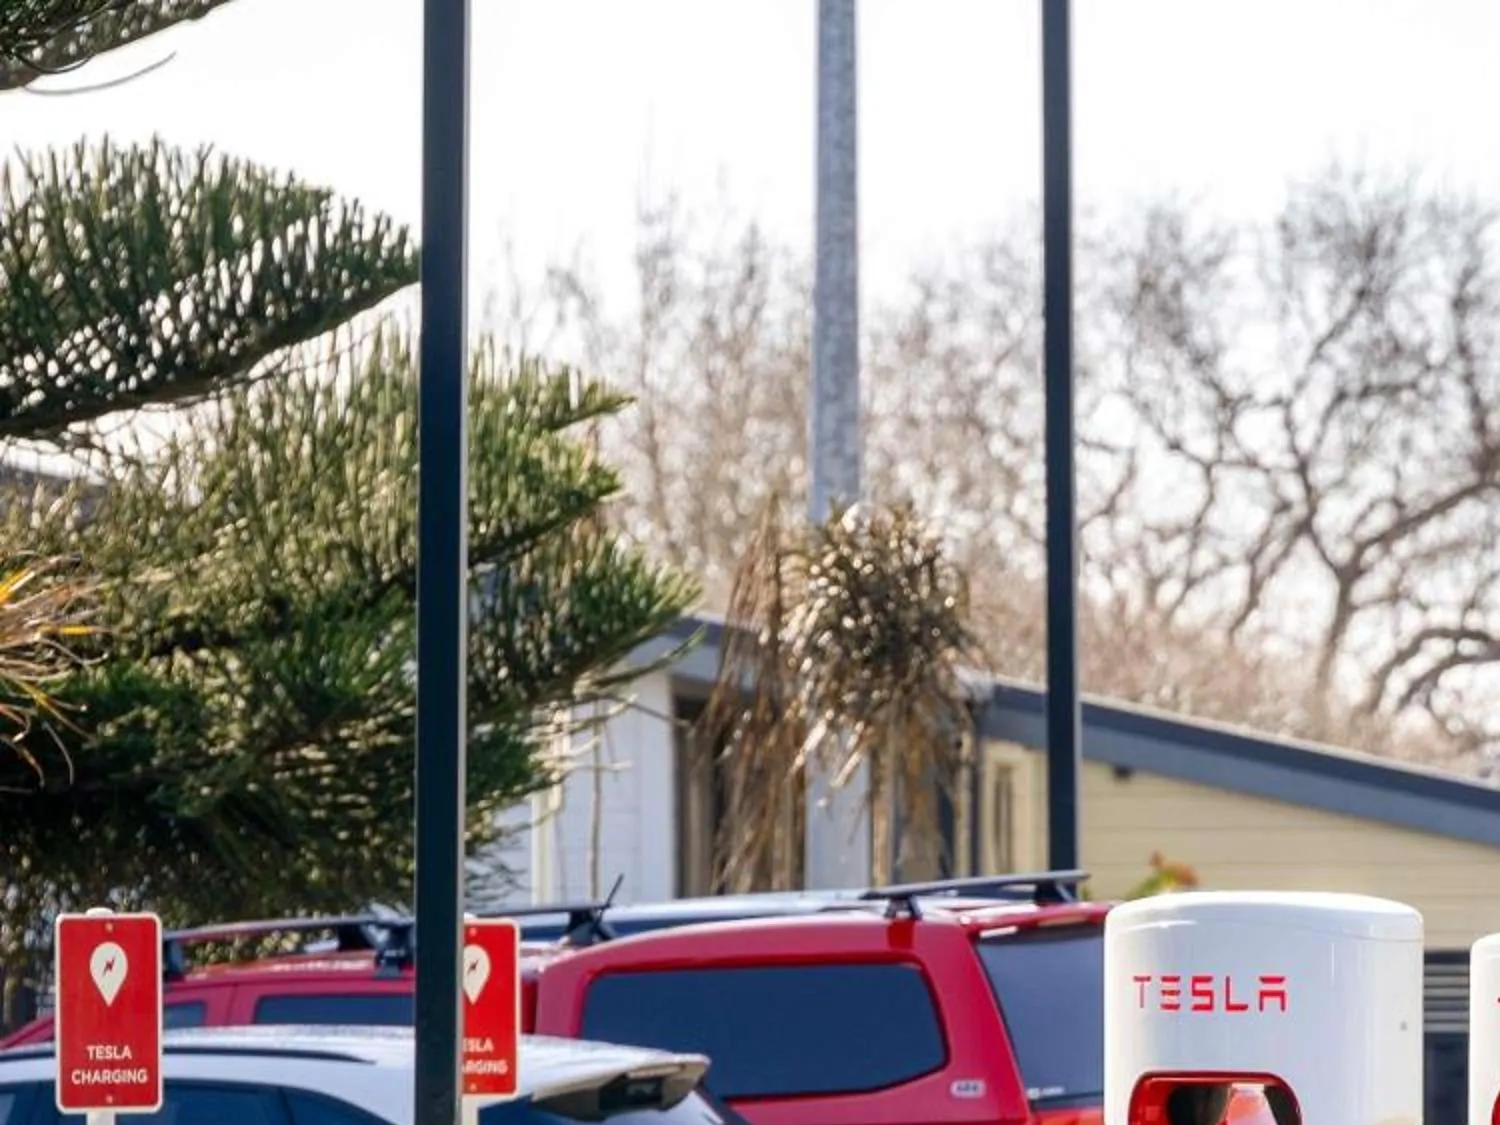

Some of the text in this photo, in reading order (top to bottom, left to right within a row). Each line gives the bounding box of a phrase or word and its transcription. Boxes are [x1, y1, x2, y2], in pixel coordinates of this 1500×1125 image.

[1133, 975, 1286, 1012] TESLA
[86, 1044, 132, 1060] TESLA
[462, 1037, 494, 1053] ESLA
[461, 1059, 509, 1075] RGING
[71, 1068, 148, 1085] CHARGING
